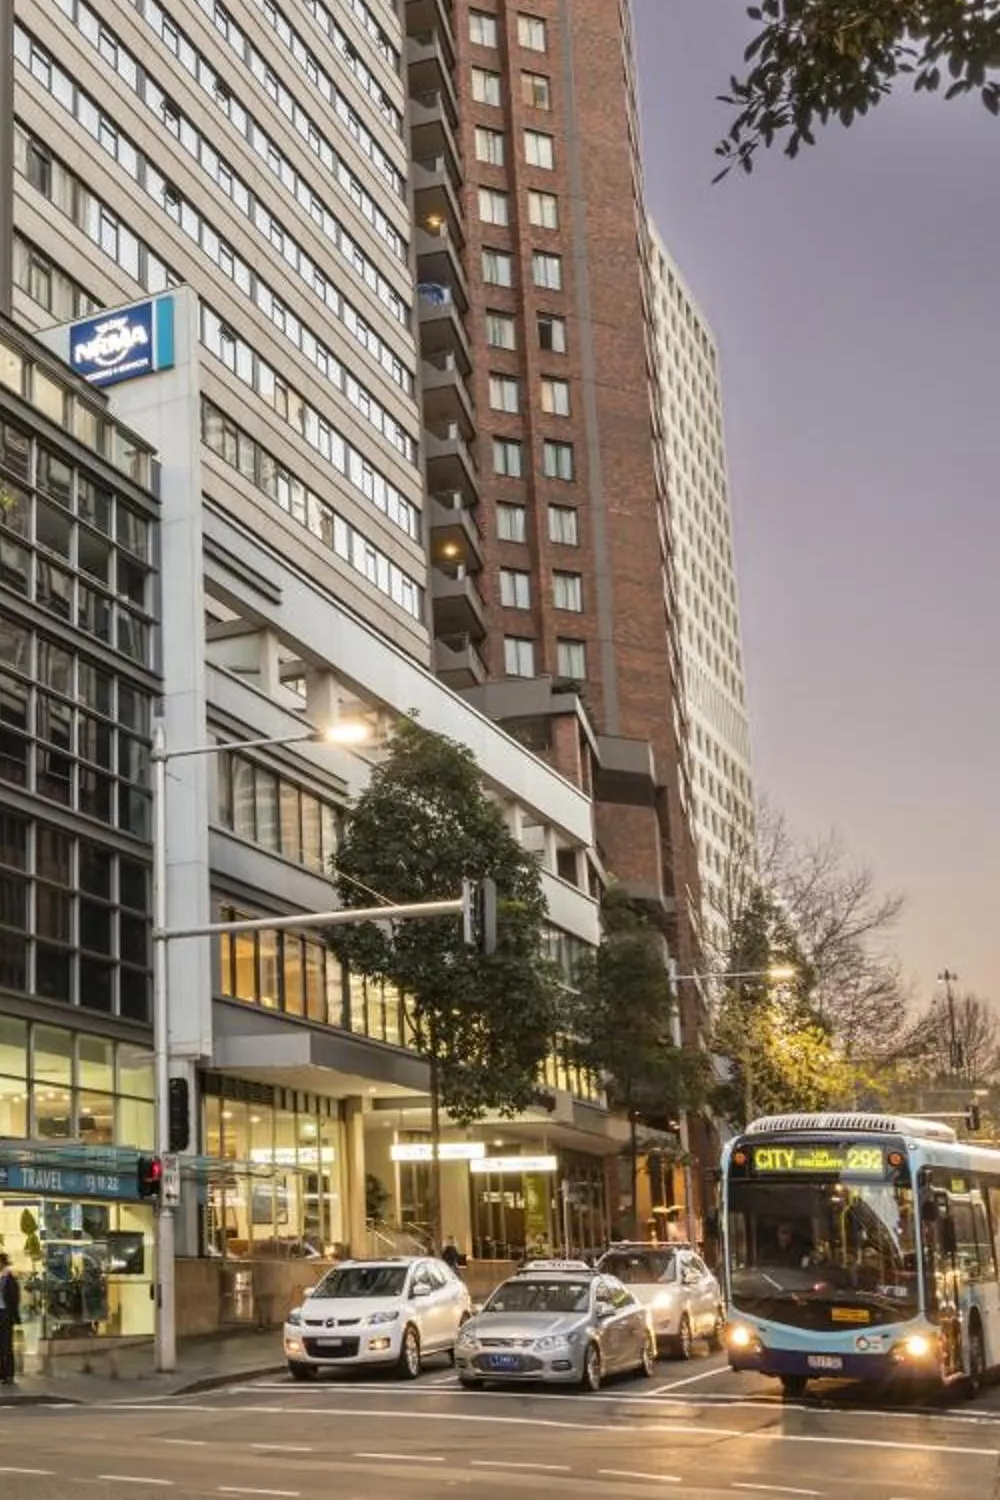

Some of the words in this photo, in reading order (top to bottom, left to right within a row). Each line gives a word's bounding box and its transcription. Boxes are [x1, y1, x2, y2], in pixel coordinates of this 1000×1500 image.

[755, 1148, 795, 1170] CITY
[847, 1149, 882, 1170] 292
[21, 1167, 63, 1191] TRAVEL
